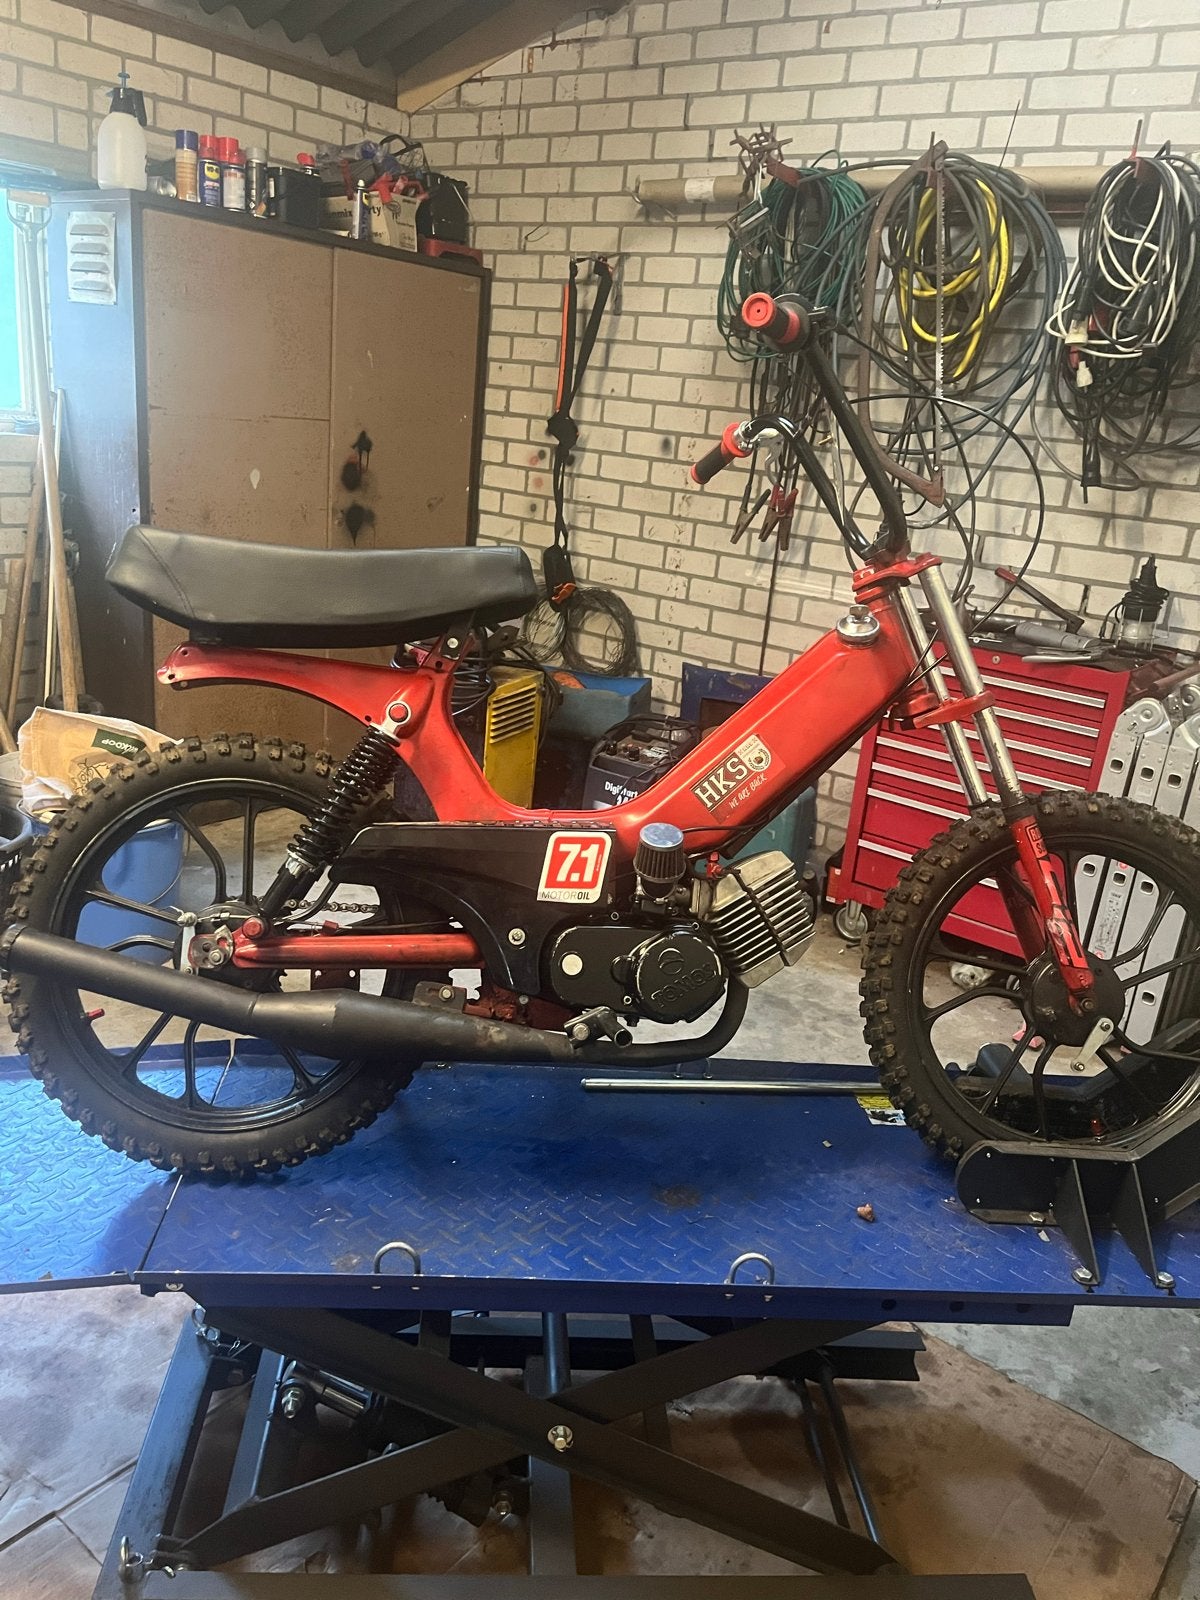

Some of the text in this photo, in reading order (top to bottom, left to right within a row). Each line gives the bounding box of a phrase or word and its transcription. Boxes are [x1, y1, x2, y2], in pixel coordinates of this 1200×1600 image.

[694, 757, 748, 808] HKS
[728, 773, 768, 809] WE ARE BACK
[556, 843, 600, 883] 7.1
